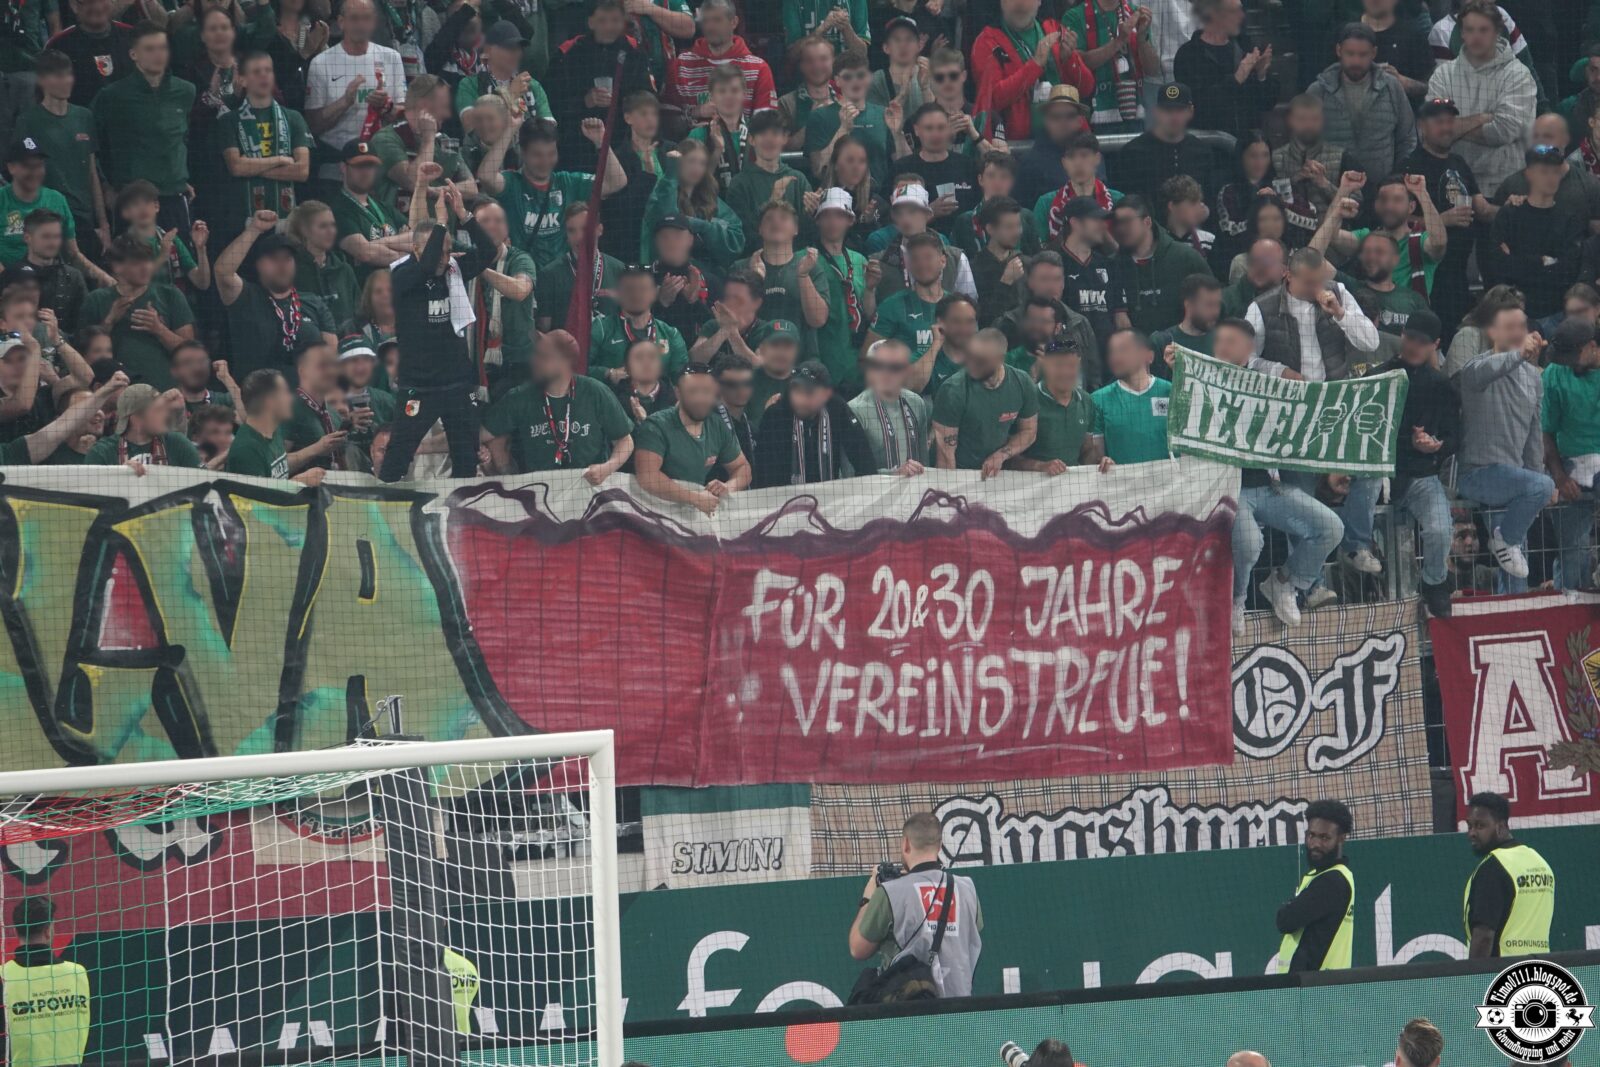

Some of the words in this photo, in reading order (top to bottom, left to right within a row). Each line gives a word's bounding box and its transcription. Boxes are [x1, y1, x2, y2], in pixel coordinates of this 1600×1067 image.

[1079, 289, 1107, 305] WWK
[530, 420, 567, 437] WET
[1182, 377, 1308, 457] TETE!
[742, 569, 846, 651] FÜR
[1021, 557, 1183, 638] JAHRE
[671, 838, 784, 875] SIMON!
